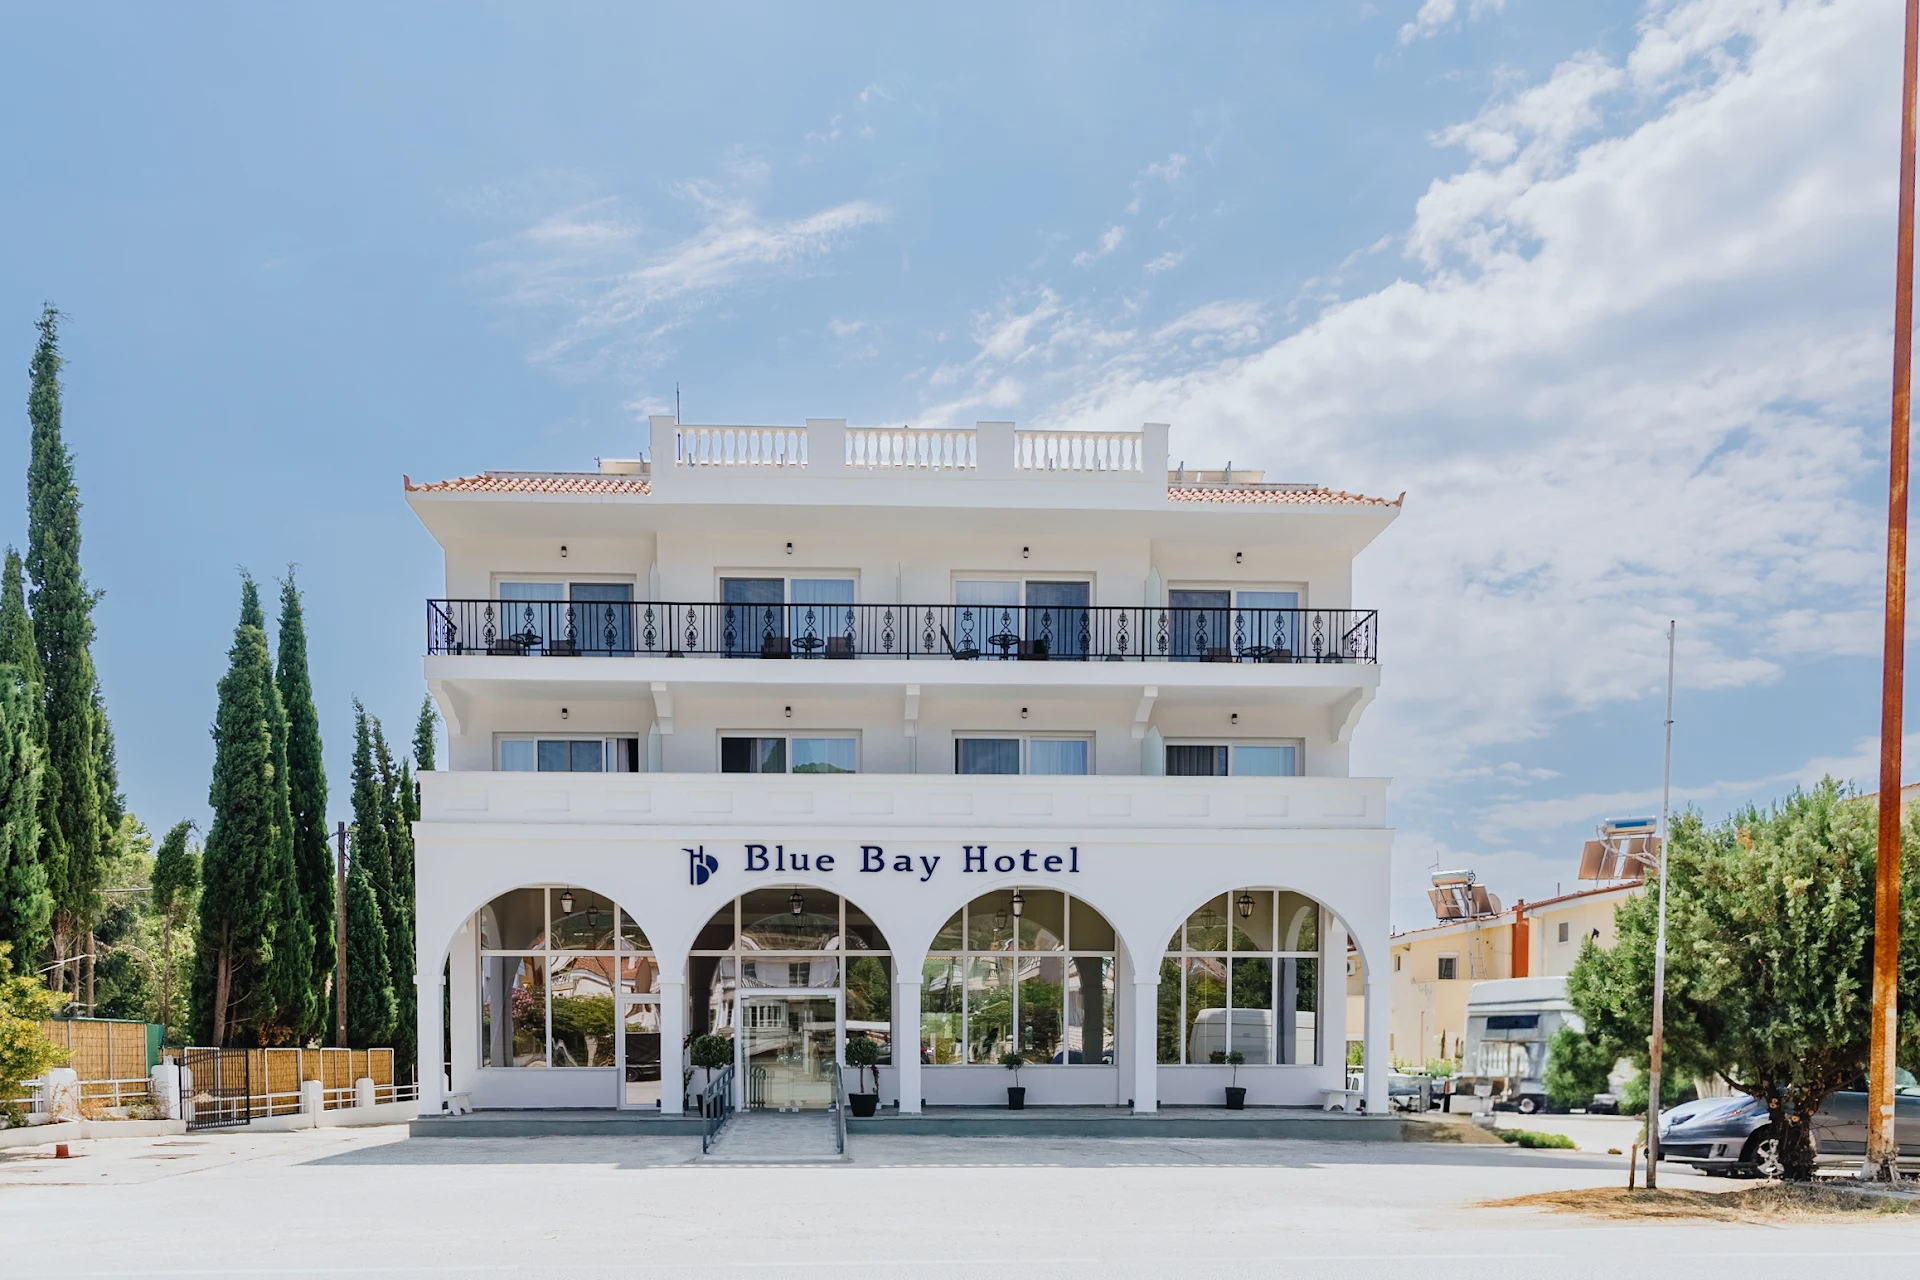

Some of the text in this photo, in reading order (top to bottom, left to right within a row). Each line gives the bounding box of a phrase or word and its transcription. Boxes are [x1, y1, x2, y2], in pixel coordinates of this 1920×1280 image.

[744, 844, 835, 872] Blue
[860, 845, 941, 882] Bay
[963, 845, 1080, 873] Hotel
